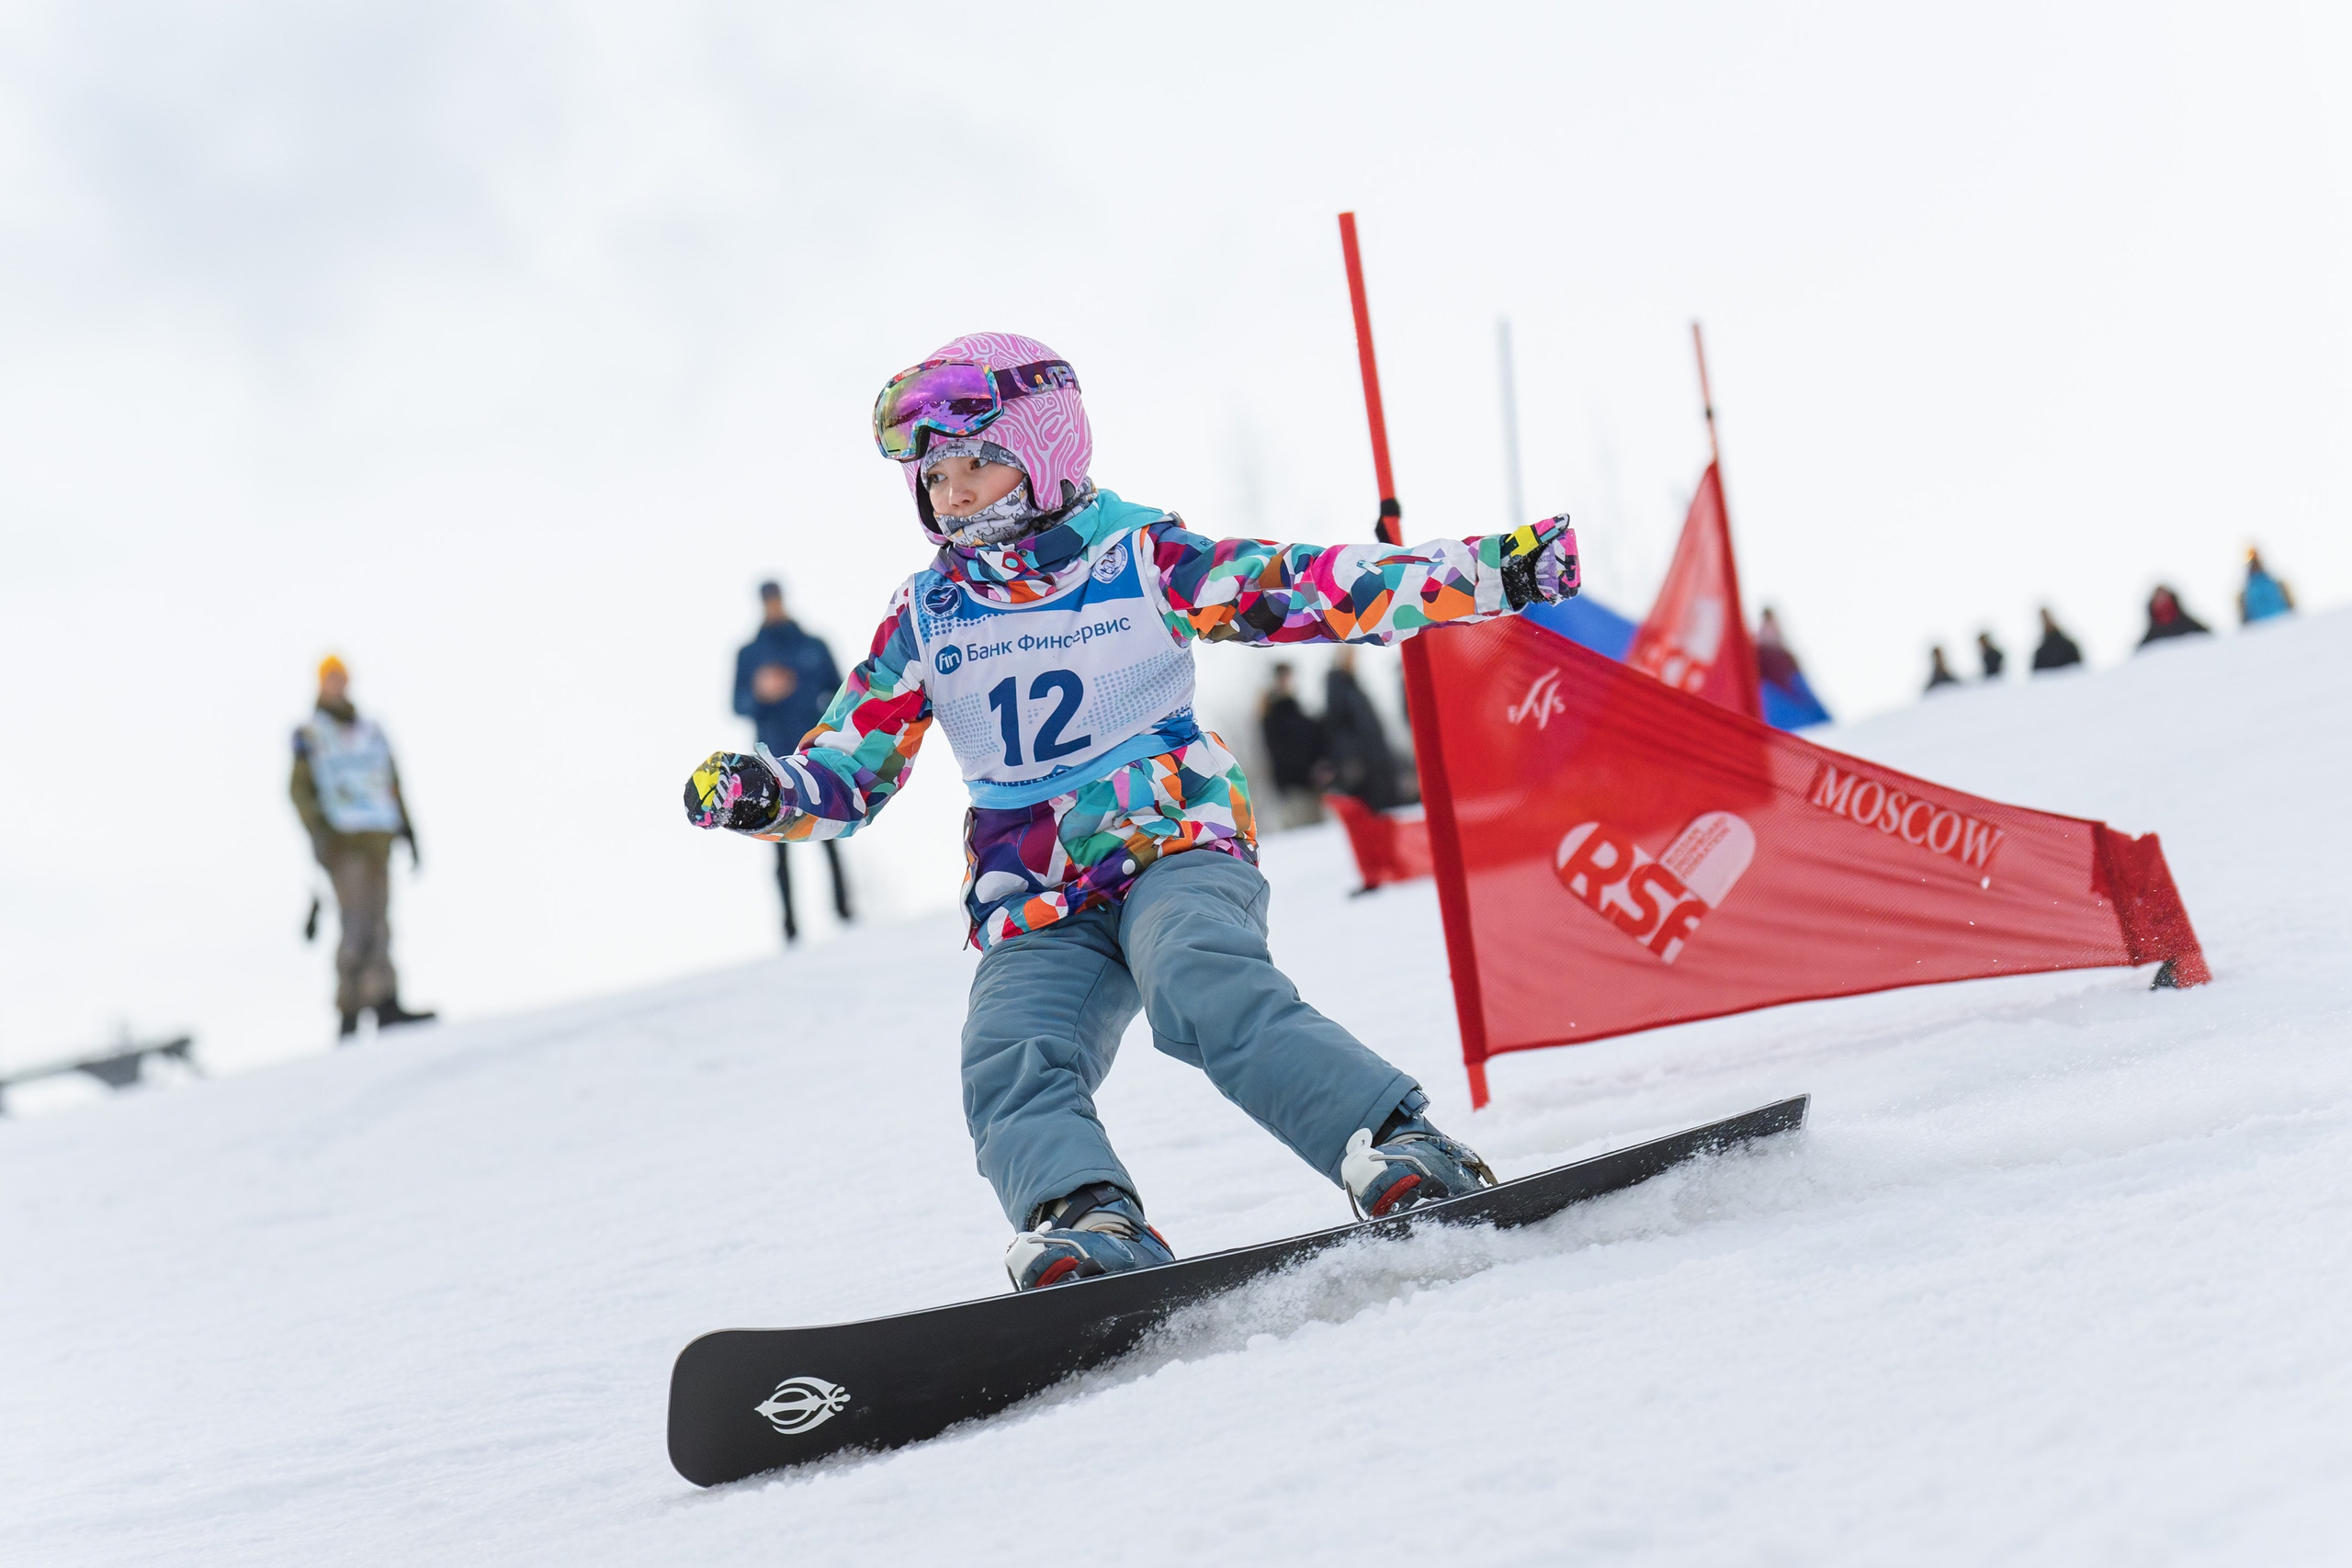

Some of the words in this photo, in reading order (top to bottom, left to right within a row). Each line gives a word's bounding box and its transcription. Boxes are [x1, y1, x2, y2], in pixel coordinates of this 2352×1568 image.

[967, 640, 1012, 661] Банк
[989, 669, 1091, 766] 12
[1813, 764, 2005, 868] MOSCOW
